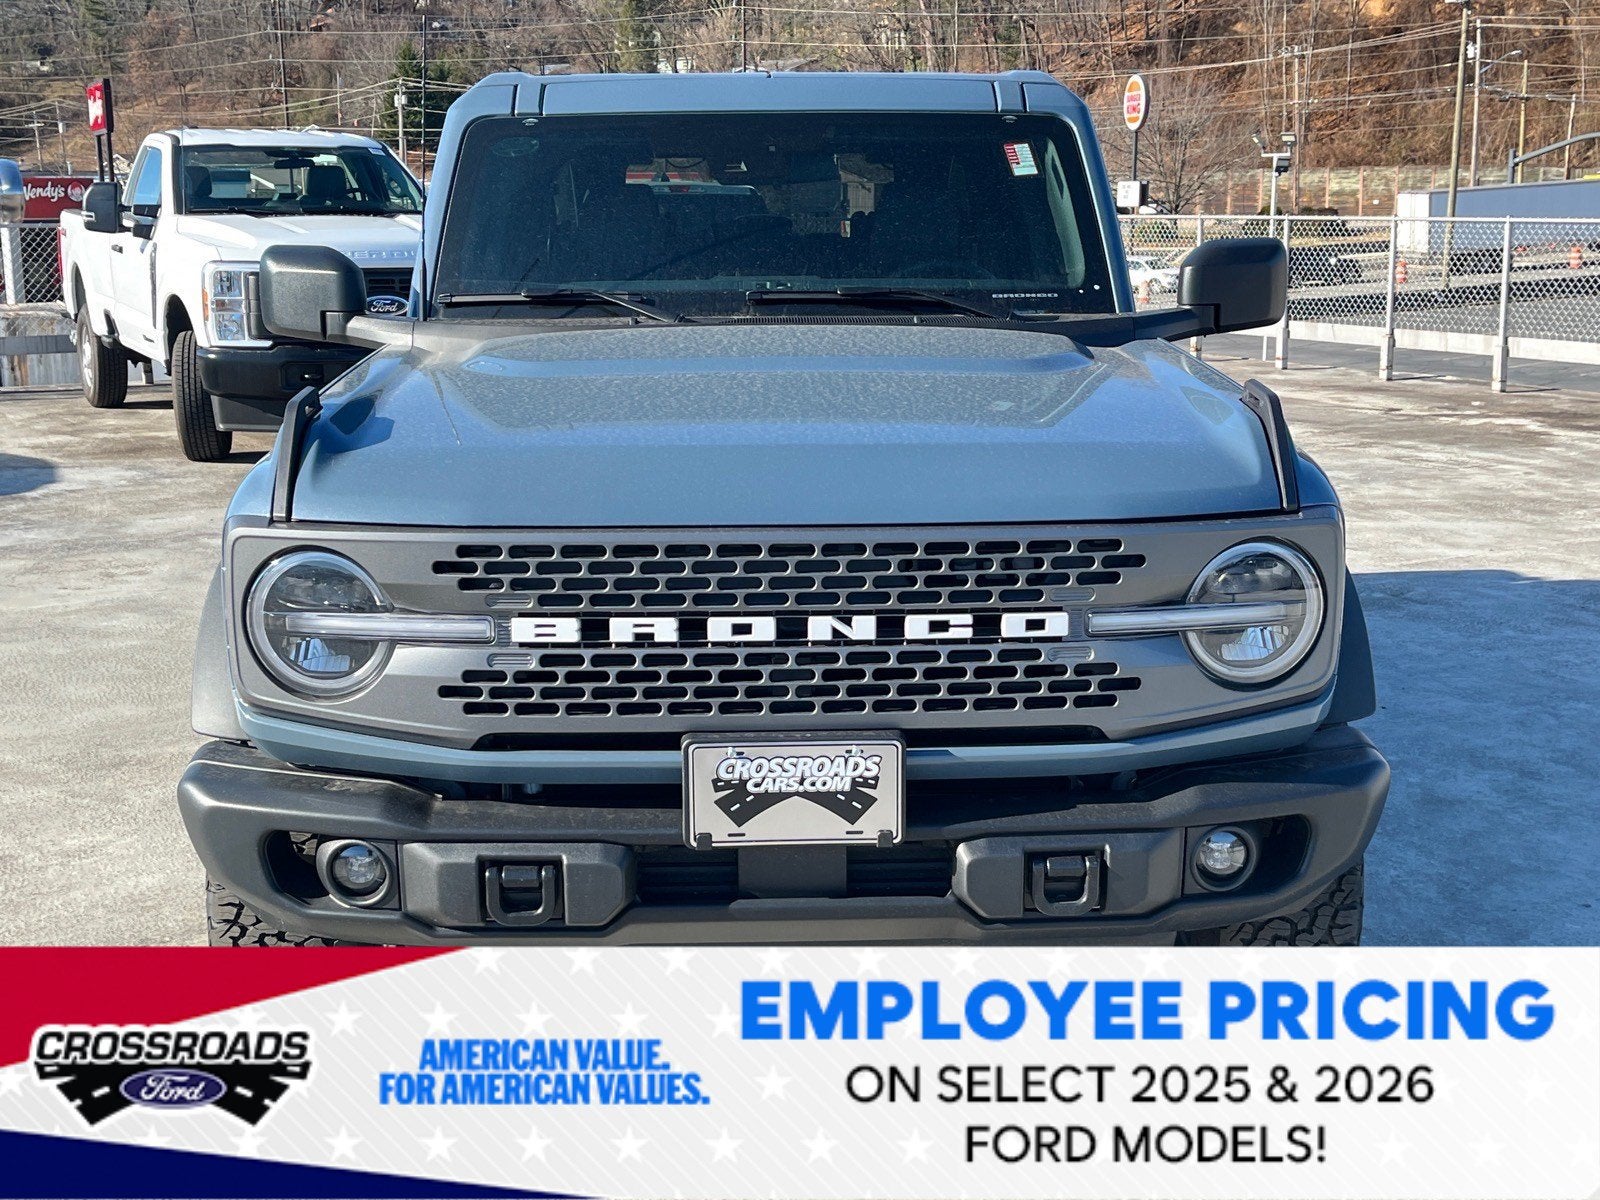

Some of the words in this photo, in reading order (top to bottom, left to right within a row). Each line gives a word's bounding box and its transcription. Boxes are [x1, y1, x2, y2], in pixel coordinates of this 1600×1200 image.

[370, 299, 399, 312] Ford
[510, 611, 1069, 644] BRONCO
[716, 755, 882, 780] CROSSROADS
[746, 776, 852, 793] CARS.COM
